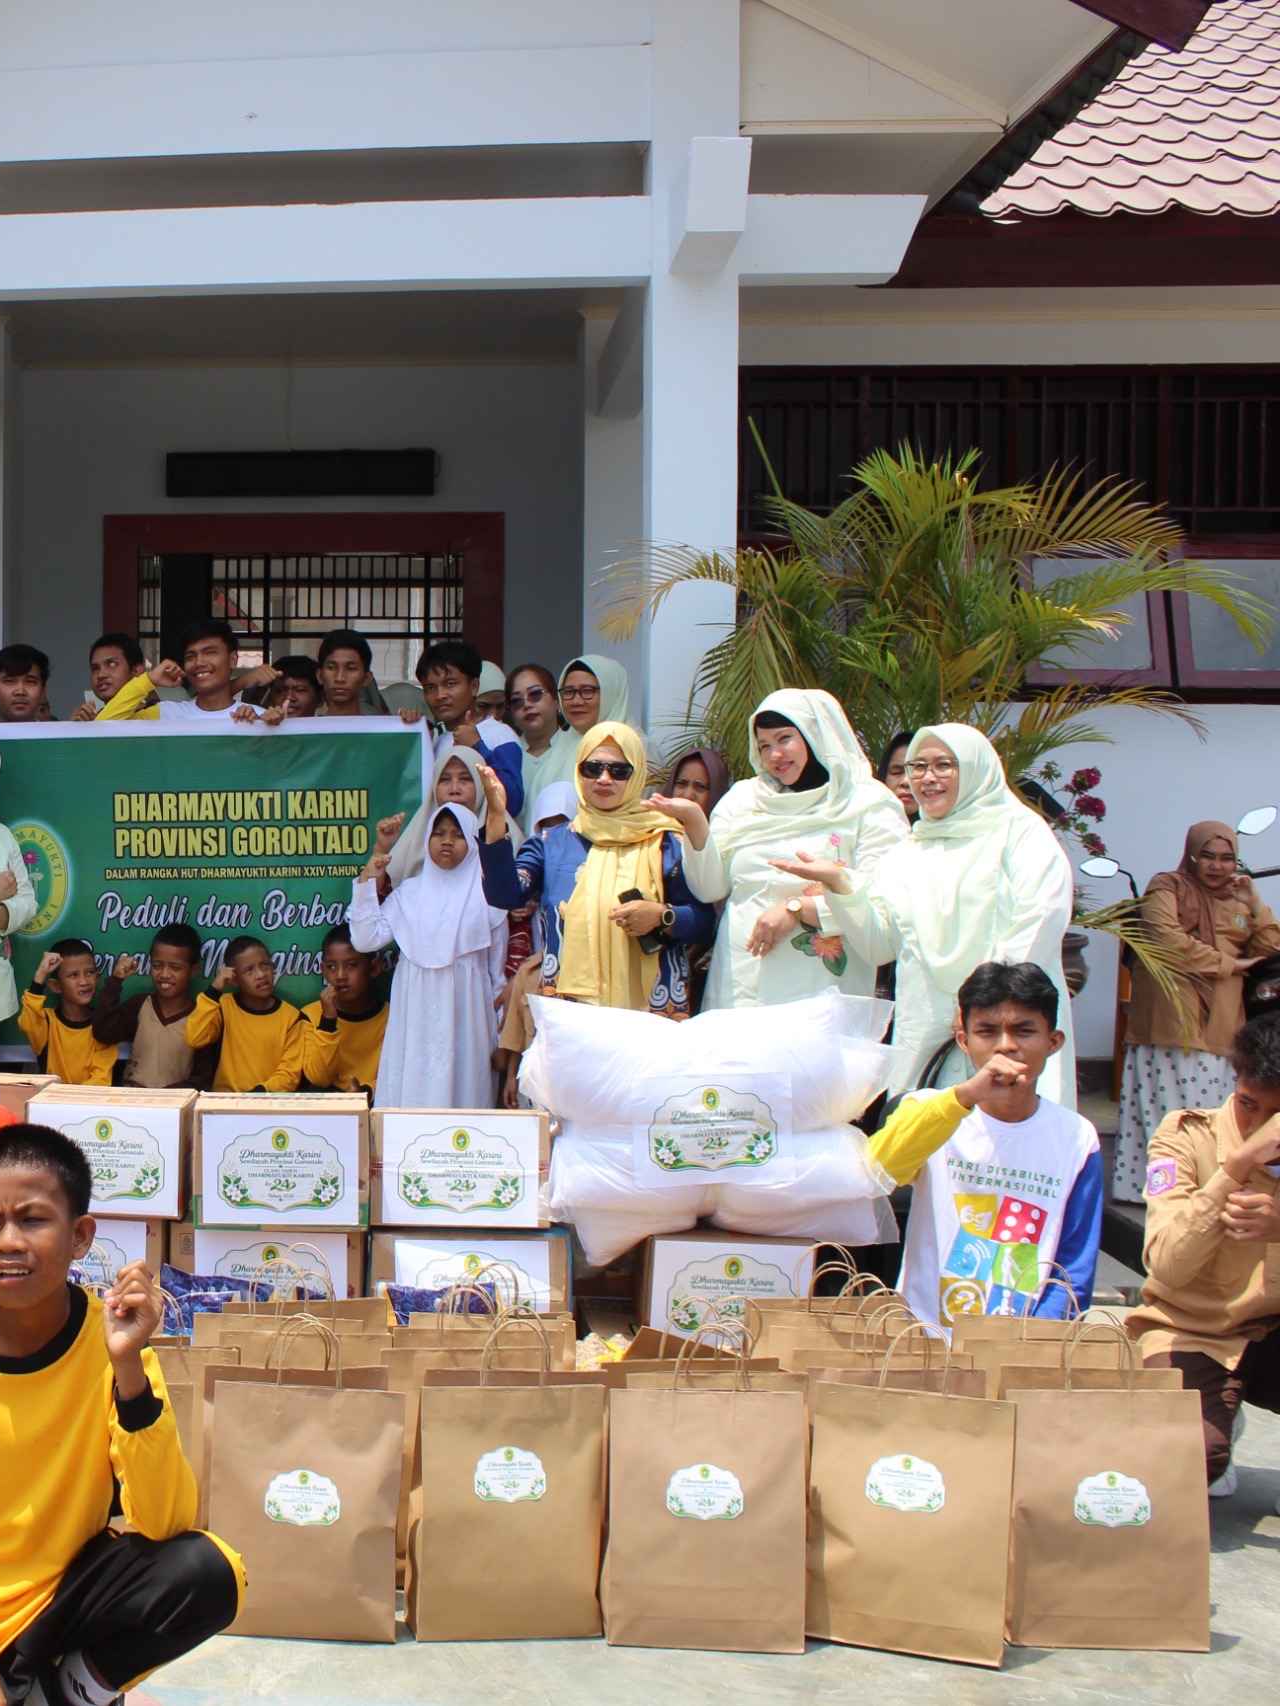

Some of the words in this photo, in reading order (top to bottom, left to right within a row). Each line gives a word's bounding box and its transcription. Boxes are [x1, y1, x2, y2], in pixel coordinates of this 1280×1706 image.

[114, 792, 282, 822] DHARMAYUKTI
[288, 790, 368, 820] KARINI
[115, 827, 226, 858] PROVINSI
[232, 825, 368, 856] GORONTALO
[16, 831, 62, 877] MAYUKTI
[105, 868, 138, 880] DALAM
[140, 868, 178, 880] RANGKA
[180, 868, 198, 879] HUT
[200, 867, 268, 879] DHARMAYUKTI
[269, 867, 301, 879] KARINI
[302, 867, 326, 878] XXIV
[328, 866, 358, 877] TAHUN
[97, 891, 190, 932] Peduli
[197, 892, 252, 929] dan
[261, 889, 351, 931] Berba
[726, 1108, 754, 1118] Karini
[73, 1140, 116, 1149] harmayukti
[117, 1140, 144, 1149] Karini
[239, 1149, 294, 1159] Dharmayukti
[295, 1149, 322, 1159] Karini
[420, 1149, 474, 1159] Dharmayukti
[475, 1149, 502, 1160] Karini
[93, 1168, 113, 1181] 24
[948, 1157, 979, 1172] HARI
[987, 1165, 1062, 1187] DISABILTAS
[952, 1171, 1058, 1199] INTERNASIONAL
[690, 1275, 747, 1286] Dharmayukti
[748, 1277, 775, 1287] Karini
